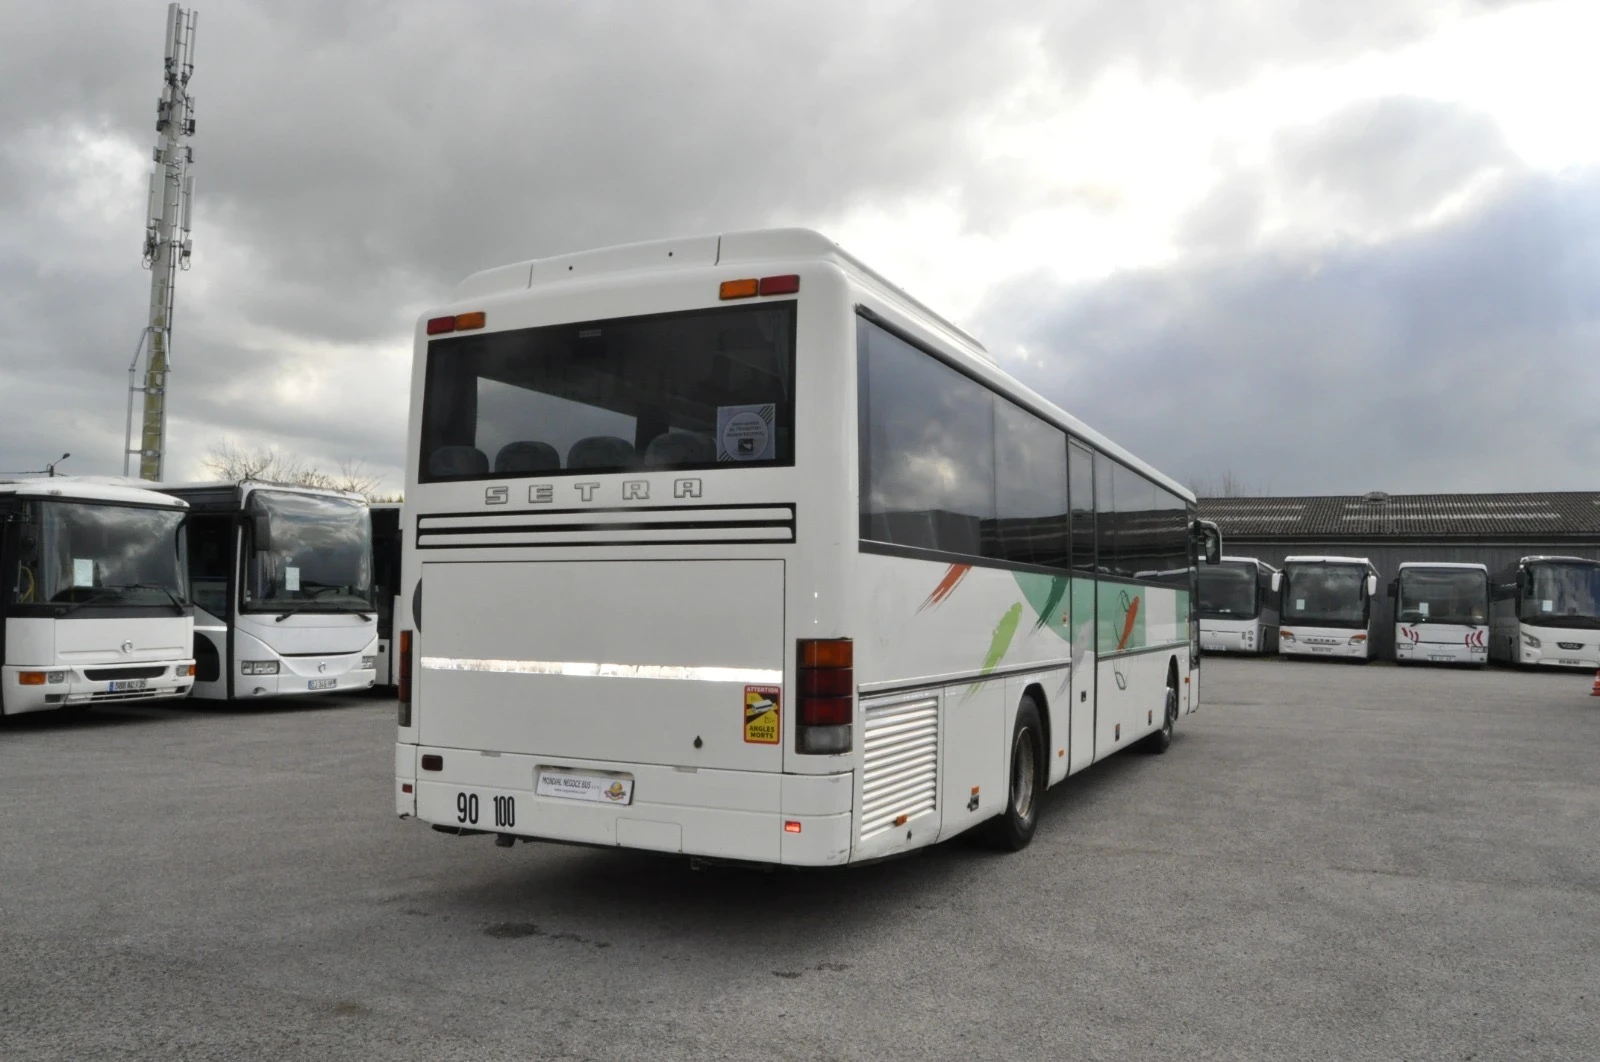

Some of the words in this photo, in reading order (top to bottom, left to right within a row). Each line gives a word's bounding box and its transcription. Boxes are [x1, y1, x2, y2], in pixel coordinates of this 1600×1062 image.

[485, 478, 702, 505] SETRA
[749, 725, 775, 733] ANGLES
[542, 776, 562, 787] MONDIAL
[563, 779, 581, 789] NEGOCE
[581, 780, 592, 790] BUS
[457, 792, 479, 825] 90
[493, 795, 515, 828] 100
